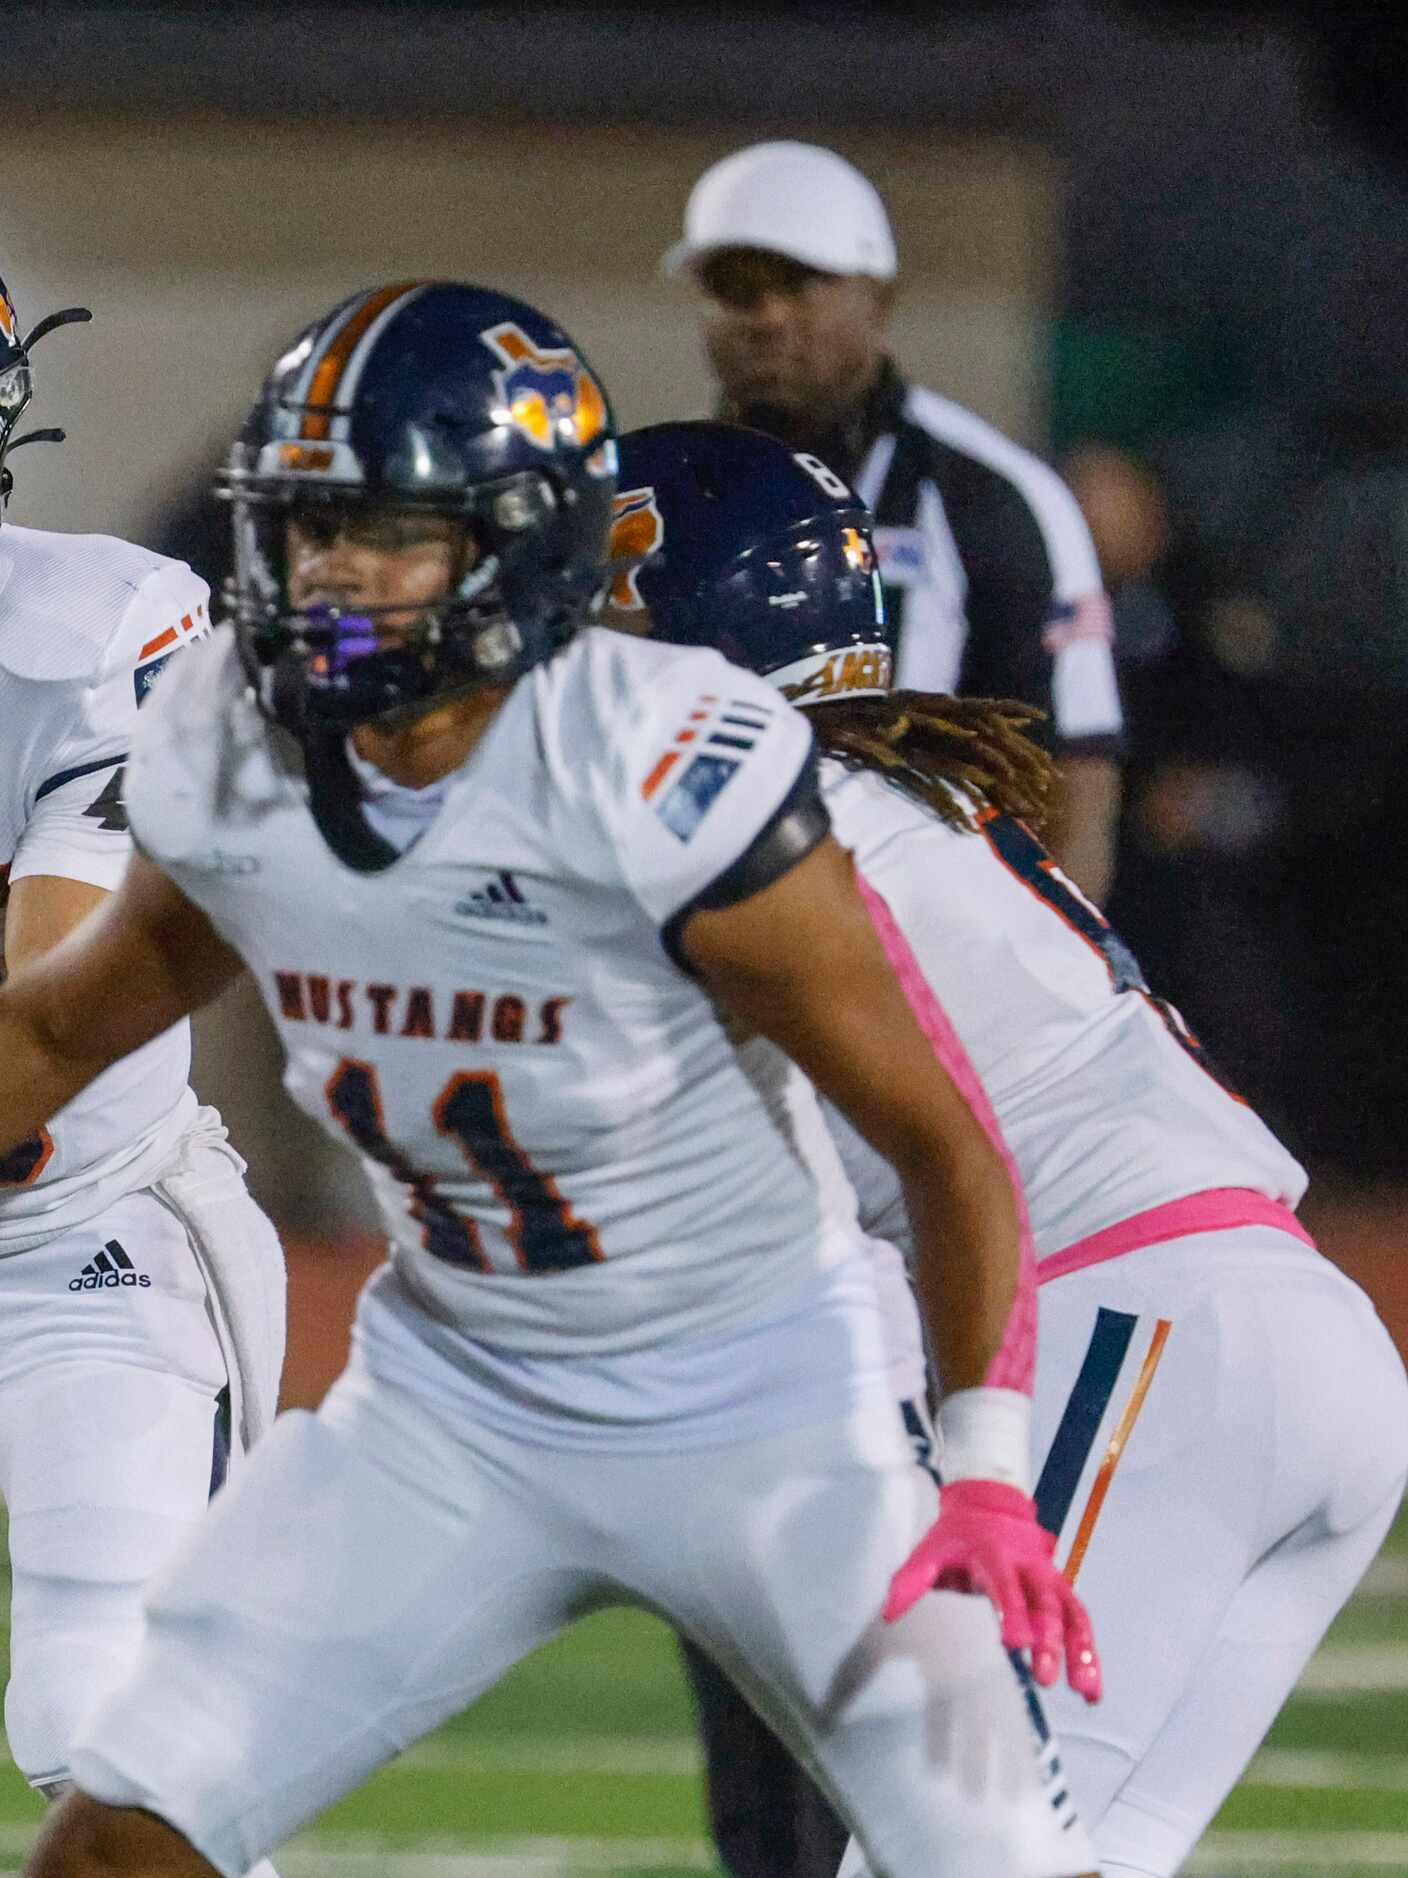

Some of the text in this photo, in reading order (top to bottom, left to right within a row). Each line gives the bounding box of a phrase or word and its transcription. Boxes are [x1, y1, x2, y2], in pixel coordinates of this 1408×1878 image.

[275, 968, 575, 1044] MUSTANGS
[324, 1057, 608, 1277] 11
[69, 1268, 152, 1291] adidas
